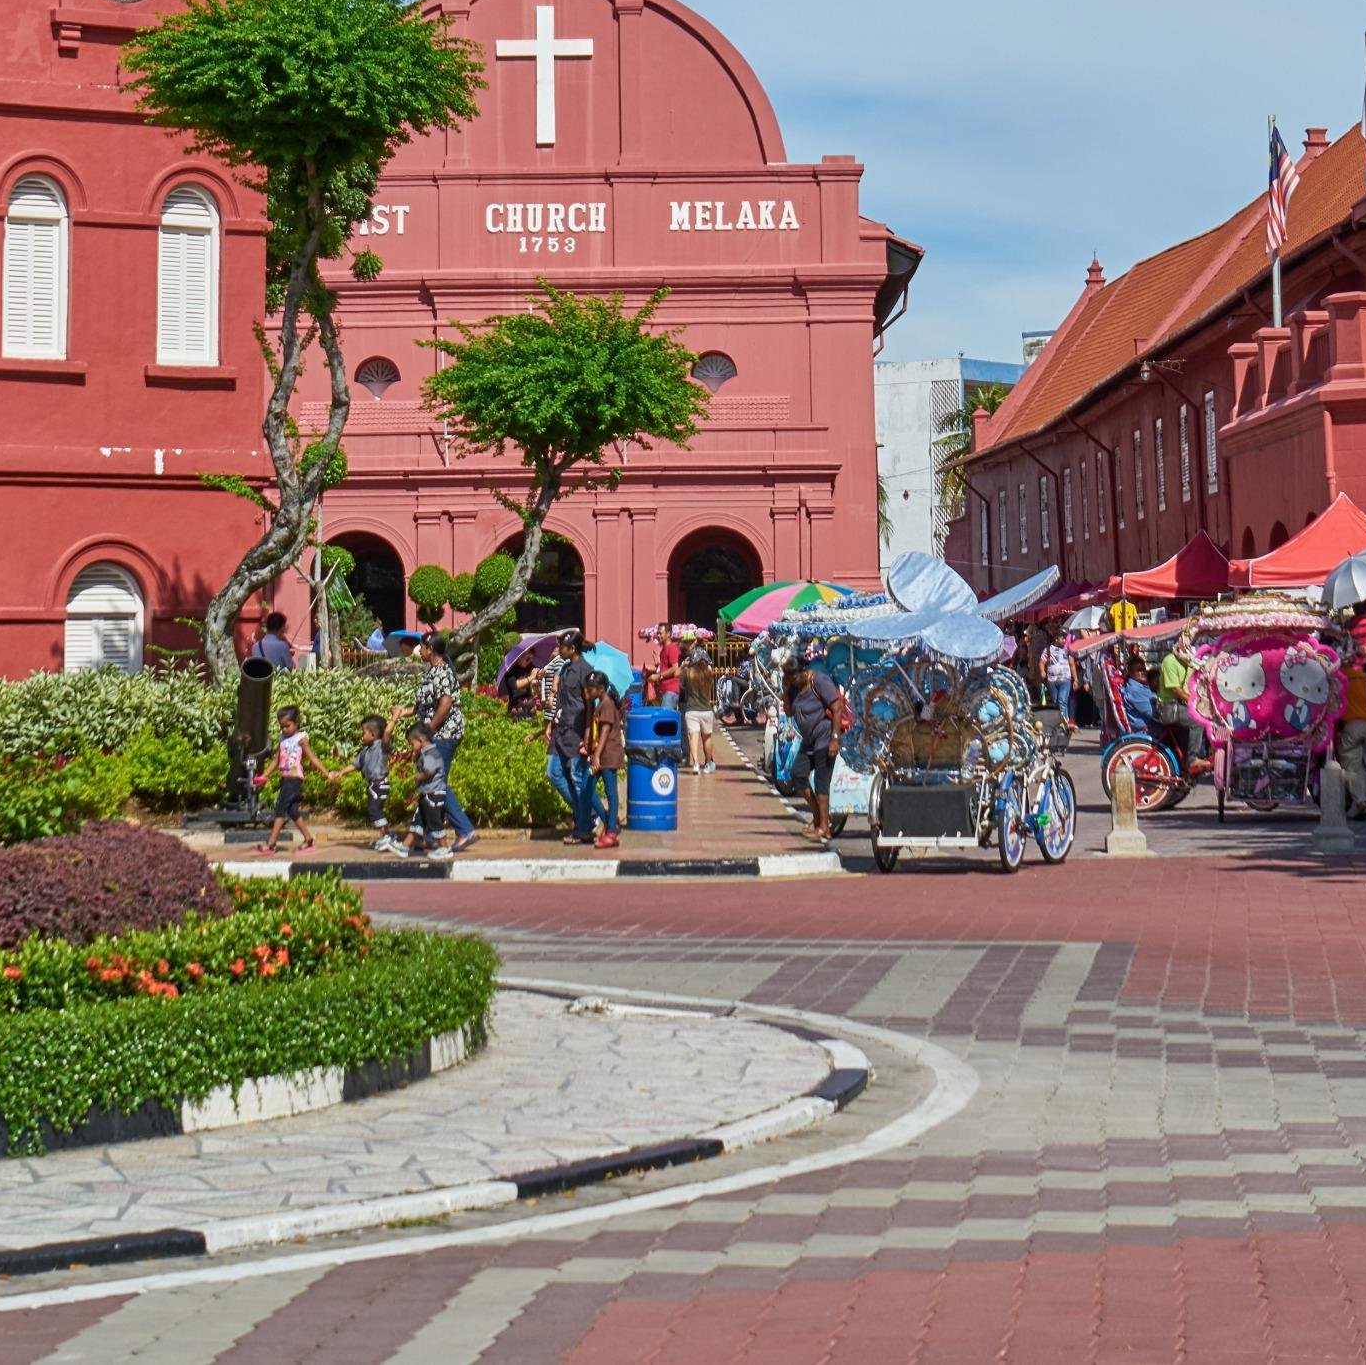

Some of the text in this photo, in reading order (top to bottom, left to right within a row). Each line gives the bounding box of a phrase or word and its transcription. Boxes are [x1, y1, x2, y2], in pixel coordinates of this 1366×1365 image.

[485, 202, 607, 233] CHURCH
[669, 200, 800, 231] MELAKA
[519, 236, 576, 253] 1753
